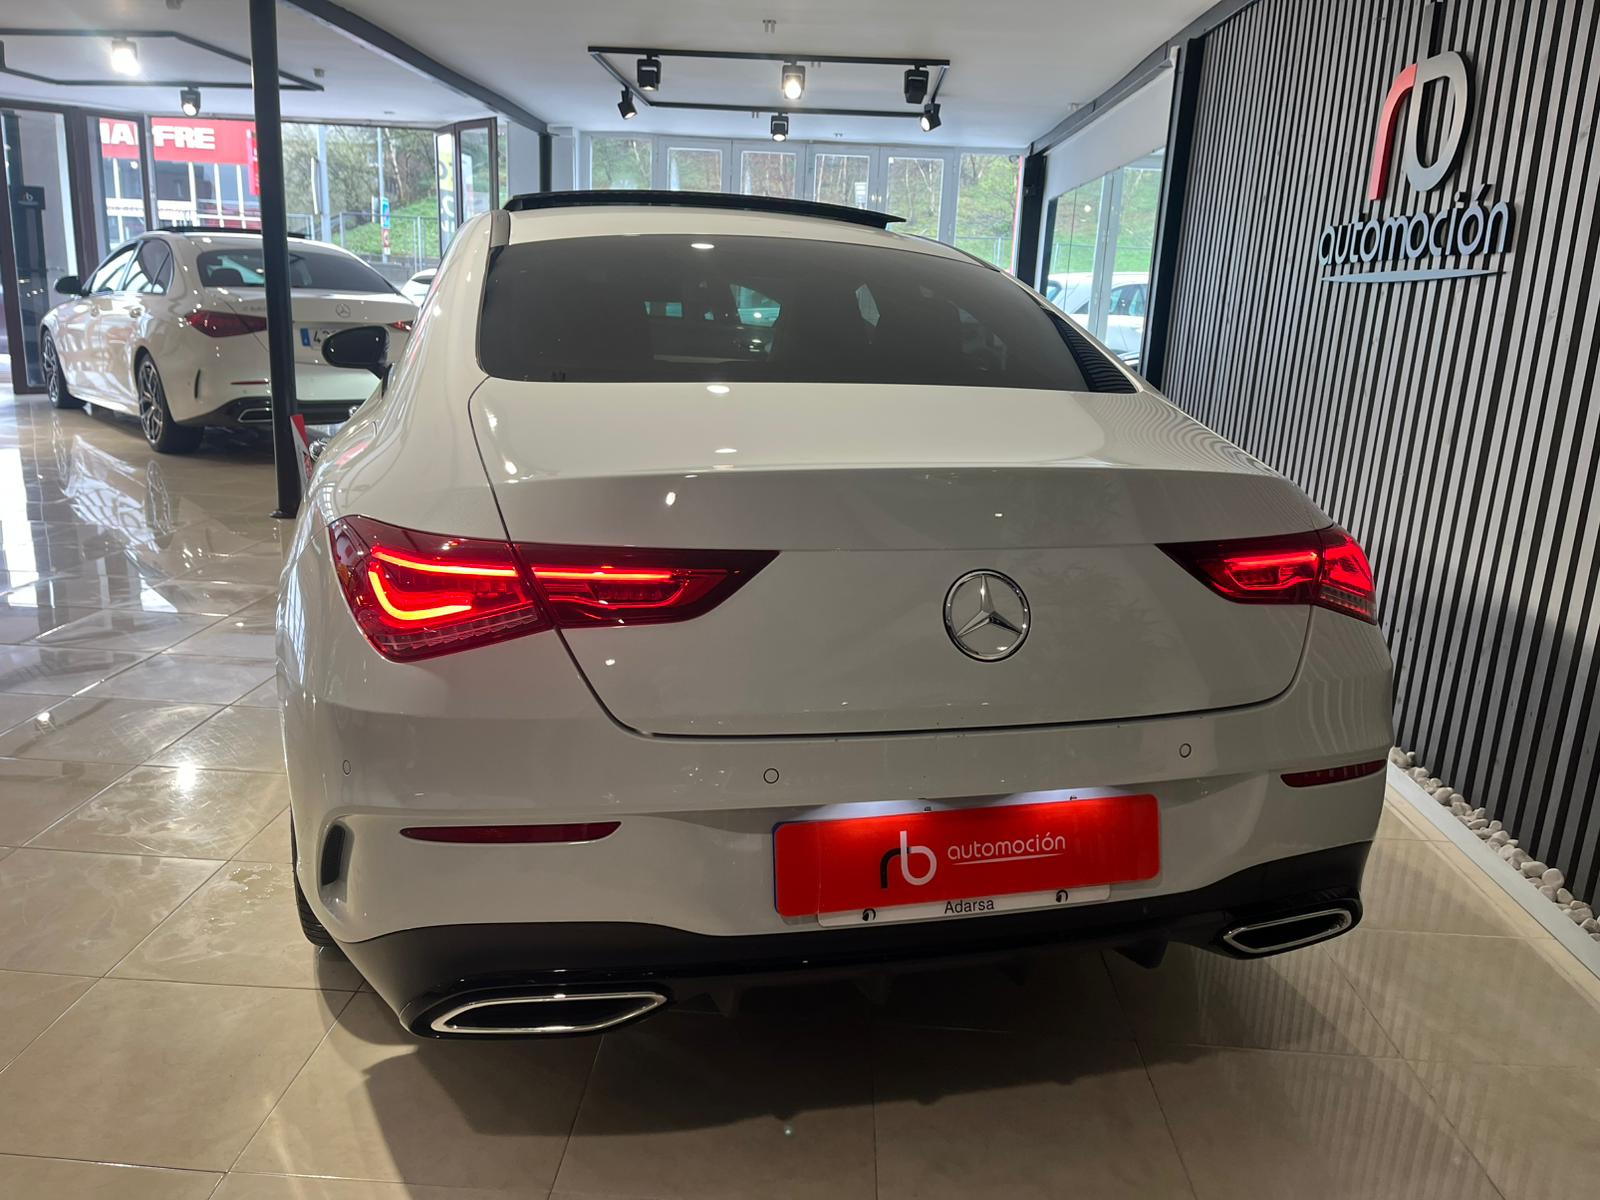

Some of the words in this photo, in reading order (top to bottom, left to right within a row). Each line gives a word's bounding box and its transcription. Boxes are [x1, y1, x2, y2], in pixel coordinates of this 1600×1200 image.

[99, 121, 216, 150] AFRE
[1318, 184, 1511, 266] automoción
[880, 830, 938, 889] rb
[947, 832, 1066, 860] automoción
[944, 899, 995, 914] Adarsa
